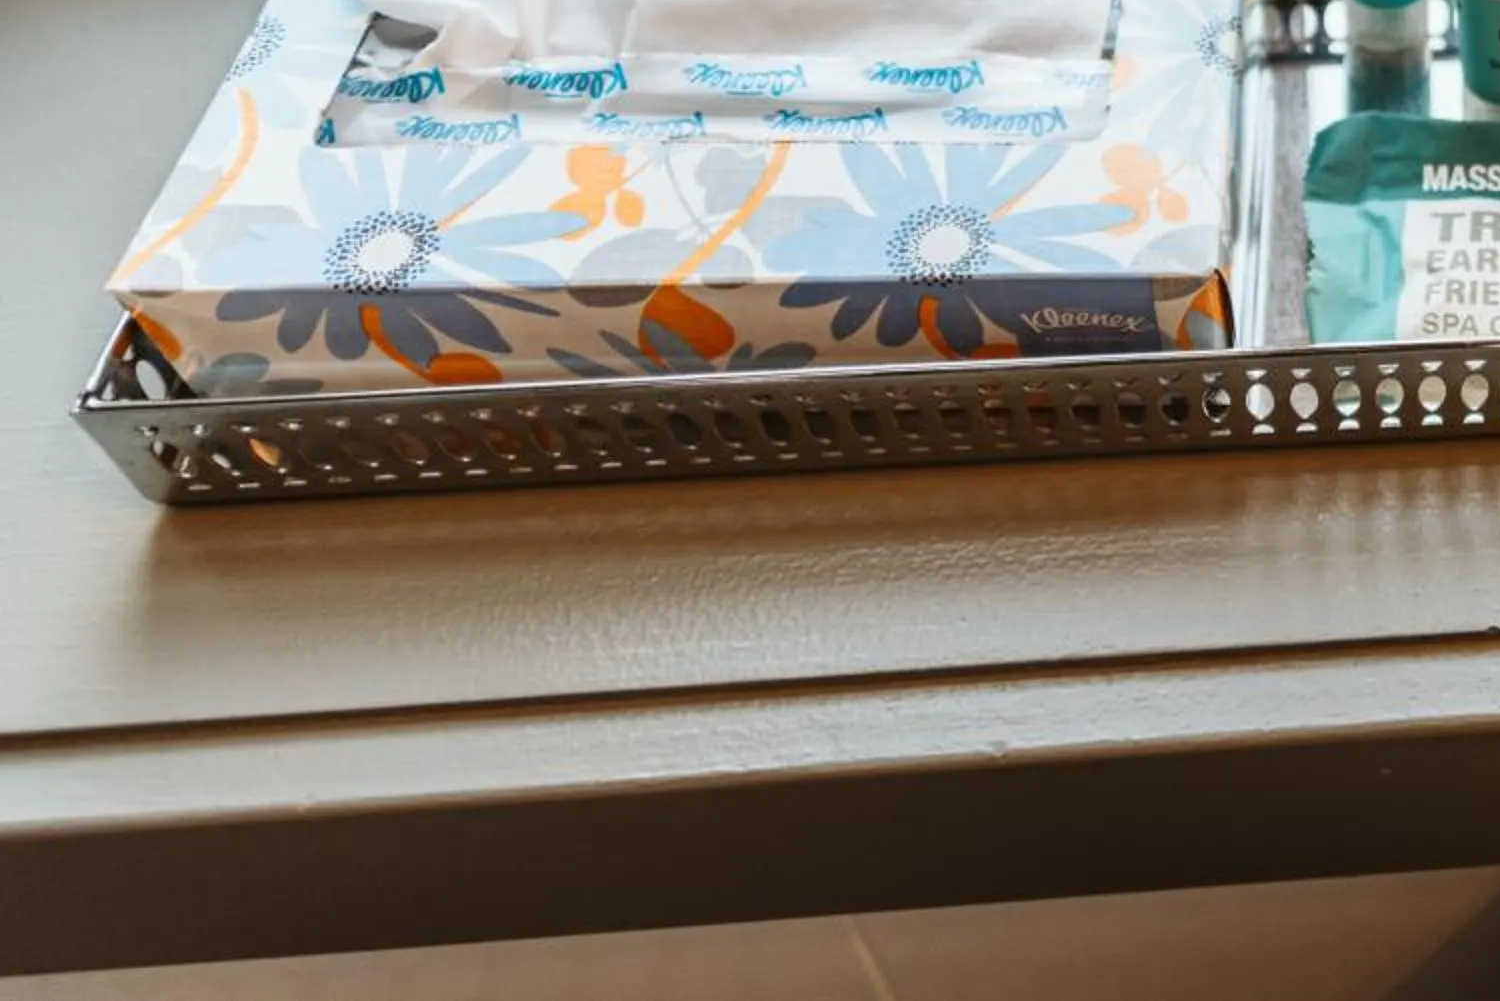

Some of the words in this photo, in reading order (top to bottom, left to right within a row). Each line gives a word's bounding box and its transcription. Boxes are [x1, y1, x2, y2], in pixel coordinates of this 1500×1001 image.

[685, 63, 807, 99] Kleenex
[867, 60, 985, 96] Kleenex
[399, 113, 522, 145] Kleenex
[946, 106, 1068, 139] Kleenex
[1019, 306, 1144, 334] Kleenex
[1421, 312, 1479, 337] SPA
